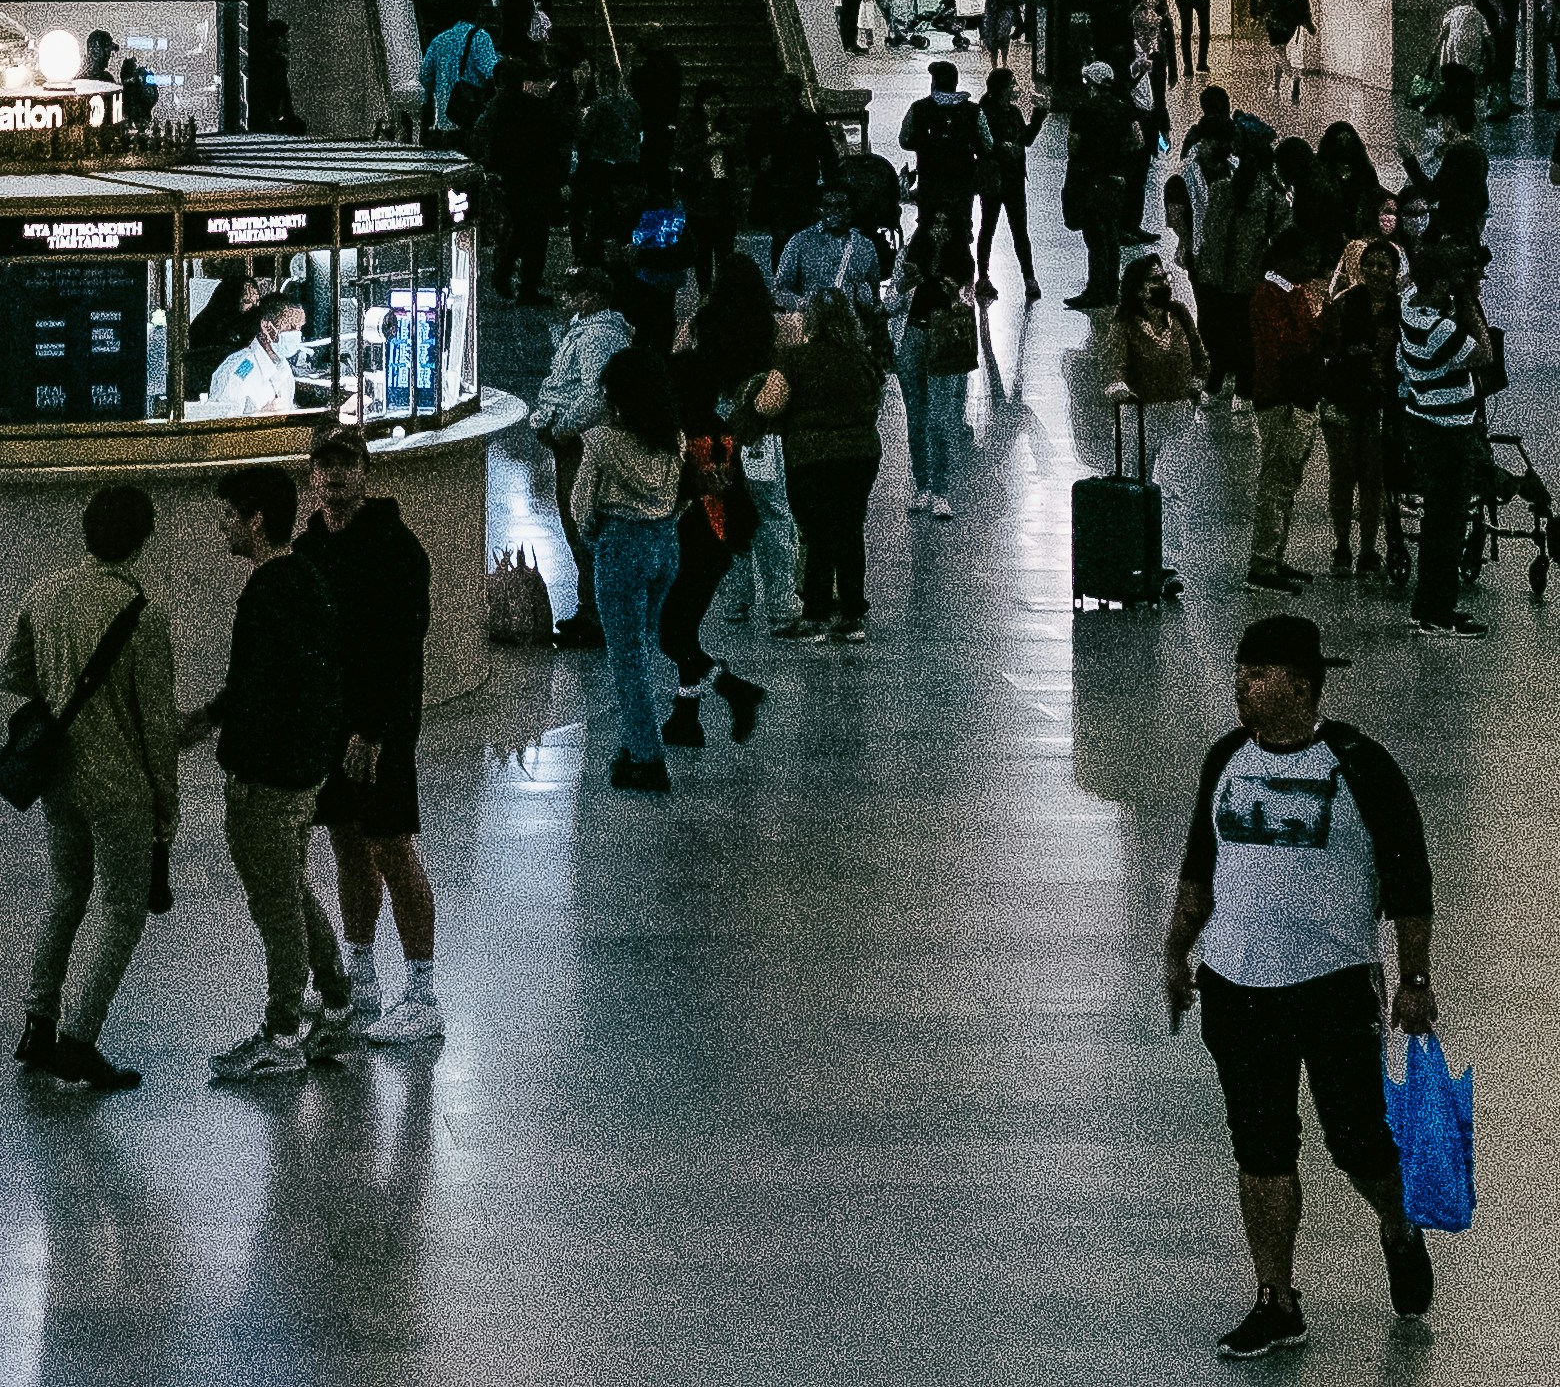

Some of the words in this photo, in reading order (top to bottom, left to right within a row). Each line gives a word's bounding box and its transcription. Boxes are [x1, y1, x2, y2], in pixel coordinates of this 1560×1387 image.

[355, 209, 369, 222] MTA
[24, 224, 50, 237] MTA
[53, 222, 143, 236] METRO-NORTH
[208, 219, 230, 232] MTA
[232, 214, 307, 231] METRO-NORTH
[352, 220, 374, 234] TRAIN
[48, 236, 119, 249] TIMETABLES
[228, 229, 288, 243] TIMETABLES
